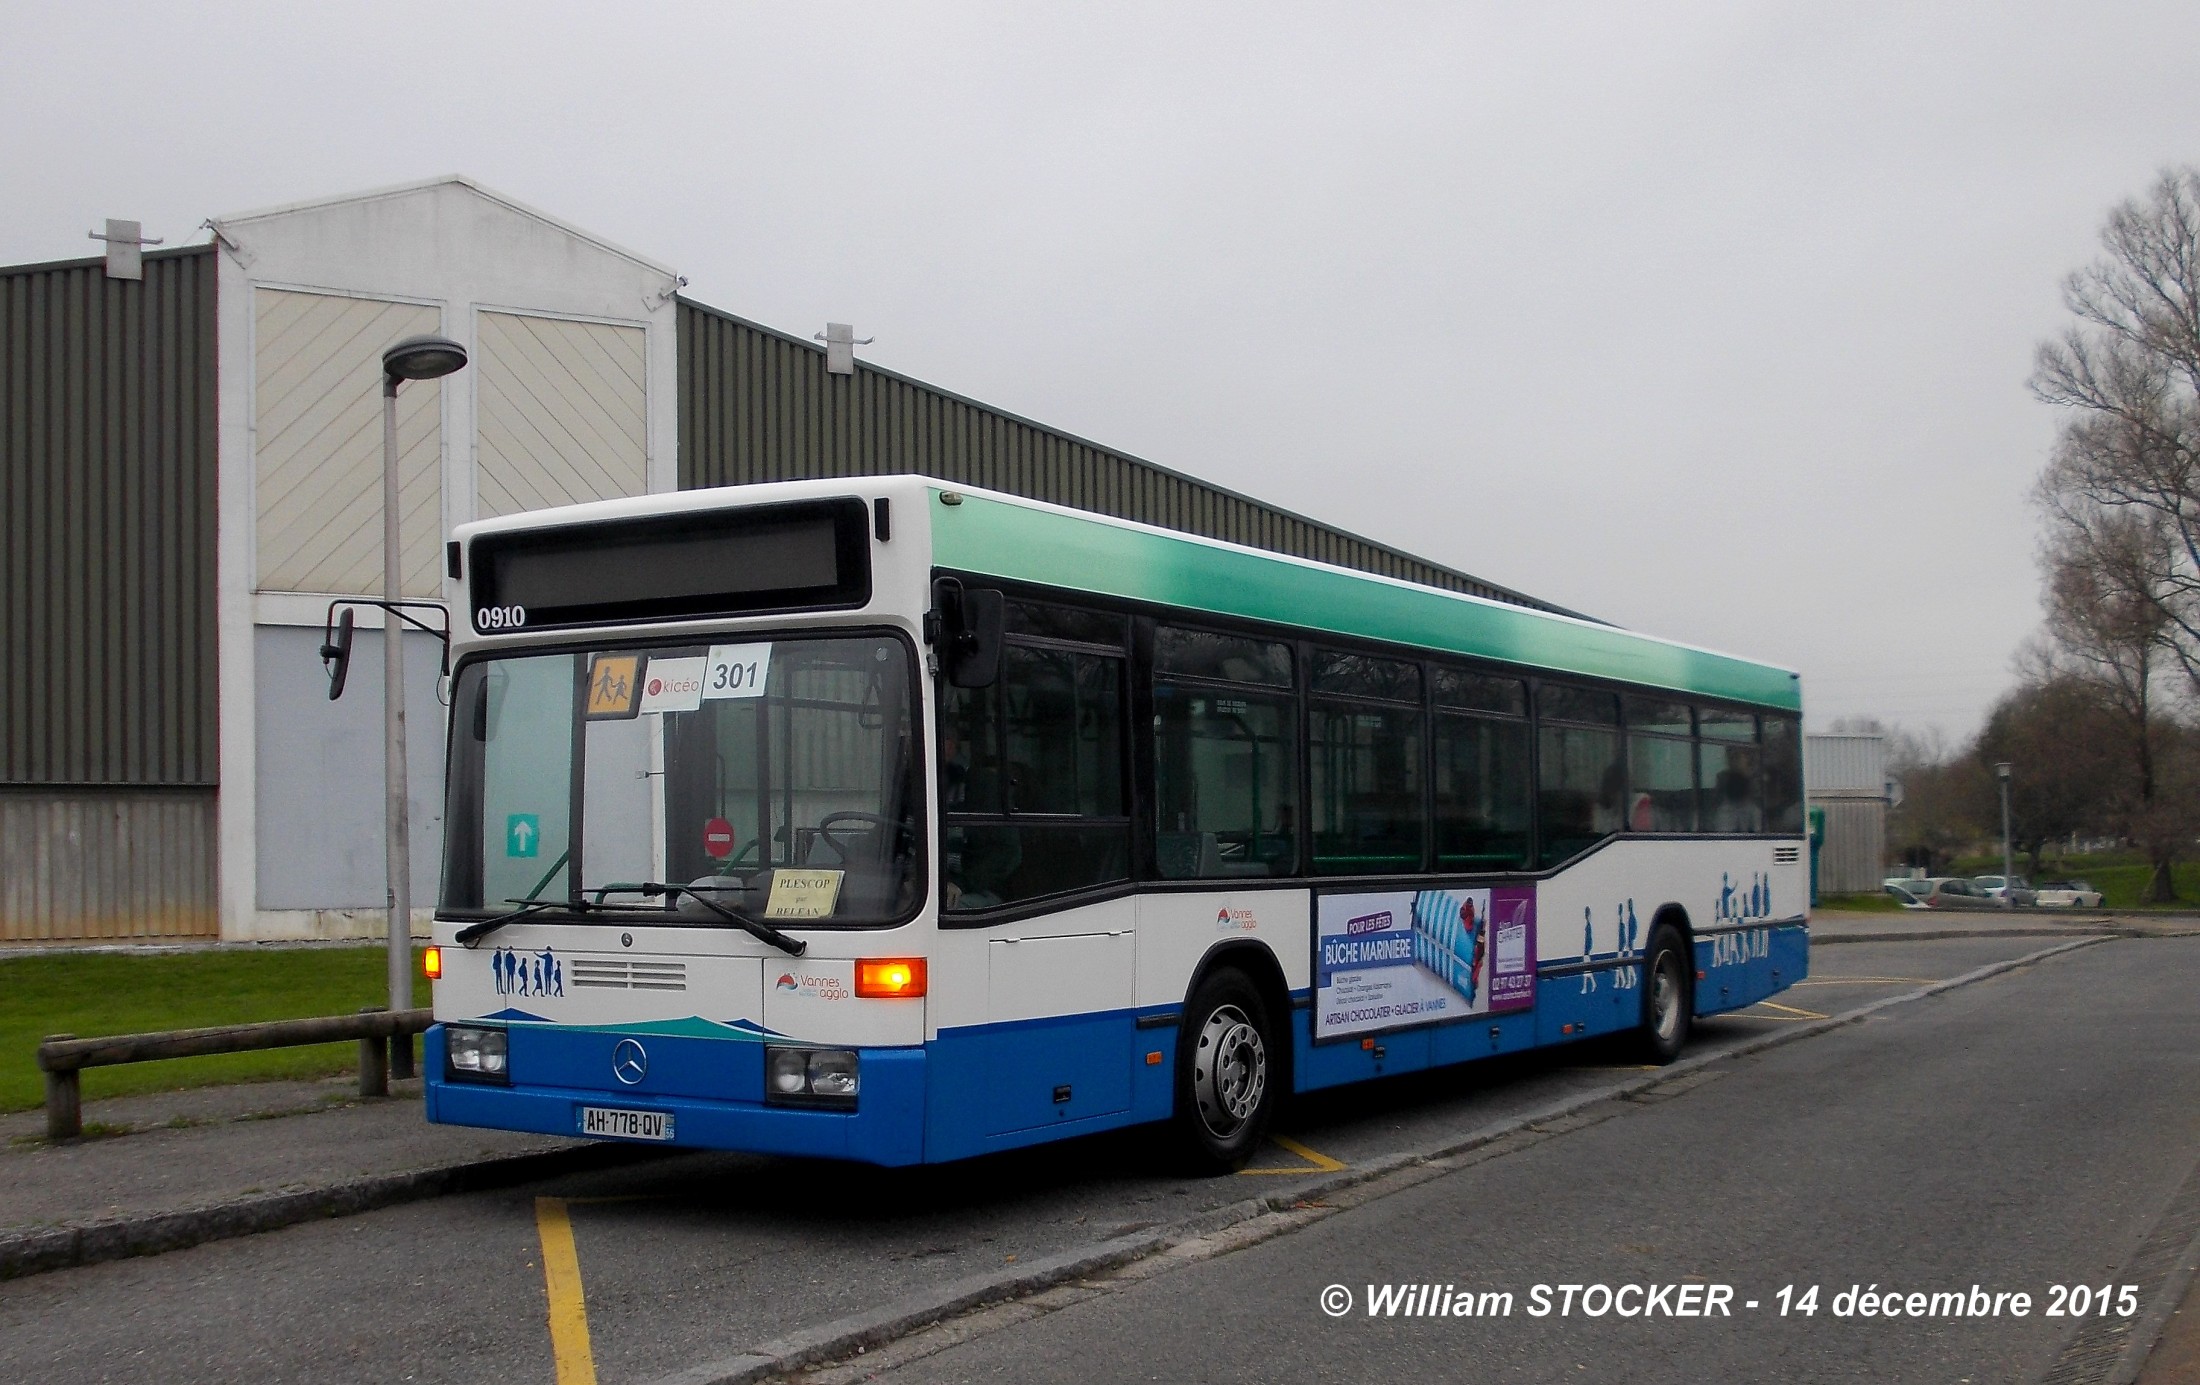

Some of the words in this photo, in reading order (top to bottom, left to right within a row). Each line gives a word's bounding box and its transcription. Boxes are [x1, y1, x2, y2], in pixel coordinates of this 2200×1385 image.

[477, 605, 525, 629] 0910
[663, 677, 699, 693] kicéo
[713, 661, 758, 690] 301
[780, 878, 830, 889] PLESCOP
[1348, 921, 1365, 935] POUR
[1365, 918, 1375, 931] LES
[1375, 914, 1391, 928] FÊTES
[1325, 938, 1358, 965] BÛCHE
[1360, 932, 1411, 962] MARINIÈRE
[800, 975, 840, 987] Vannes
[819, 988, 849, 1000] agglo
[1325, 1011, 1350, 1025] ARTISAN
[1350, 1005, 1391, 1022] CHOCOLATIER
[1394, 1002, 1419, 1016] GLACIER
[1426, 997, 1446, 1012] VANNES
[587, 1110, 662, 1136] AH-778-QV
